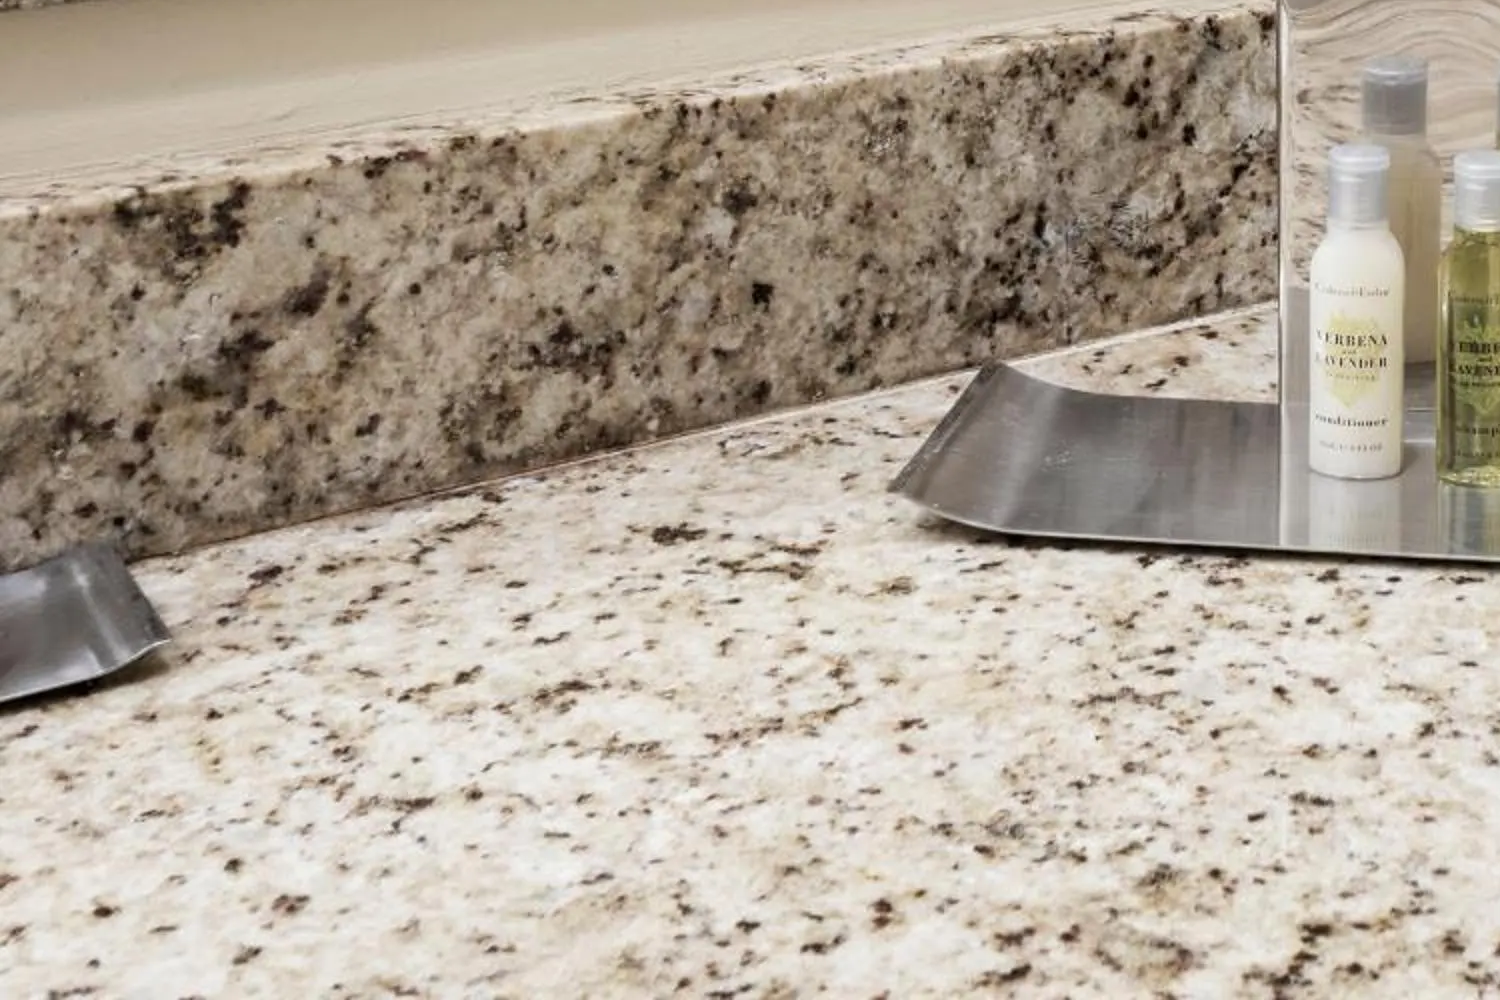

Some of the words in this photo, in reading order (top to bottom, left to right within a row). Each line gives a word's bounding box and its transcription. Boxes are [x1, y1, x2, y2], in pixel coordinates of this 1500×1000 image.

[1316, 329, 1388, 347] VERBENA
[1315, 352, 1388, 369] LAVENDER
[1314, 413, 1389, 428] conditioner
